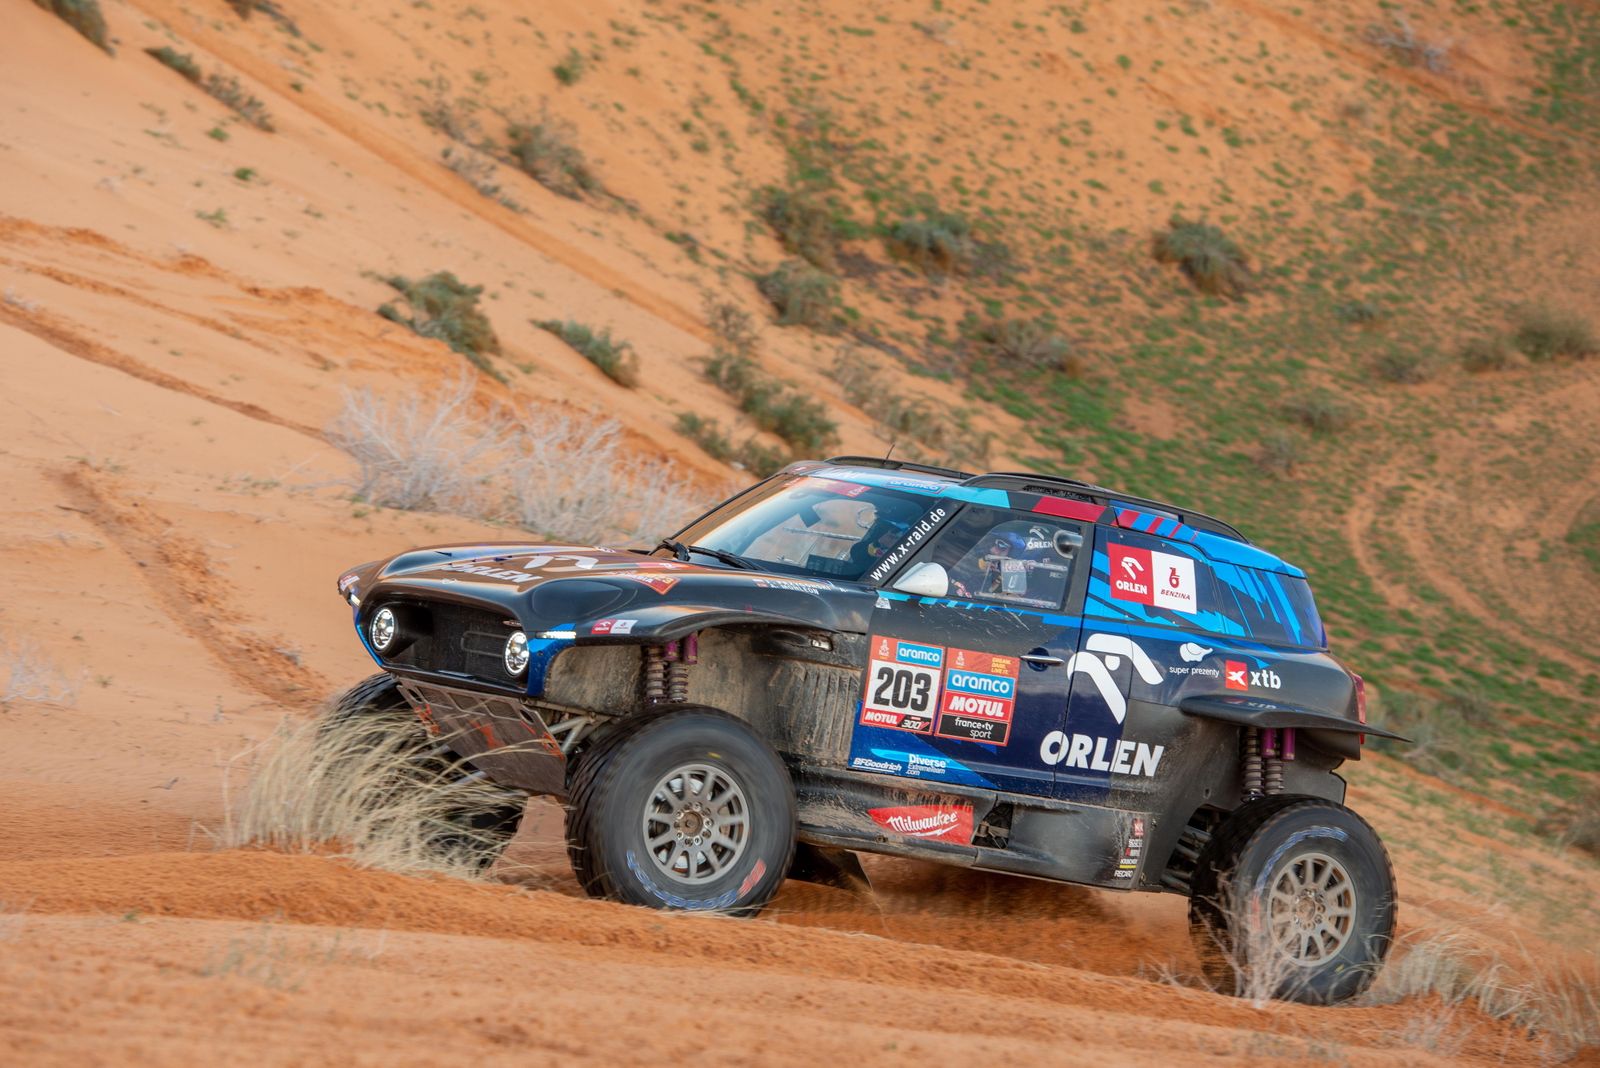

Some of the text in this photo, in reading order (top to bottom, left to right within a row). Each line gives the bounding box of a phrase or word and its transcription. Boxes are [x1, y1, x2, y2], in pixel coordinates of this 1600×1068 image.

[870, 508, 946, 581] www.x-raid.de
[1115, 579, 1148, 595] ORLEN
[1160, 589, 1191, 601] BENZINA
[899, 647, 940, 662] aramco
[1169, 666, 1220, 678] super prezenty
[1249, 669, 1281, 689] xtb
[873, 666, 932, 712] 203
[952, 674, 1010, 694] aramco
[949, 696, 1004, 717] MOTUL
[865, 711, 898, 725] MOTUL
[970, 729, 992, 739] sport
[908, 753, 946, 769] Diverse
[1040, 730, 1164, 777] ORLEN
[853, 757, 902, 771] BFGoodrich
[886, 811, 959, 832] Milwaukee
